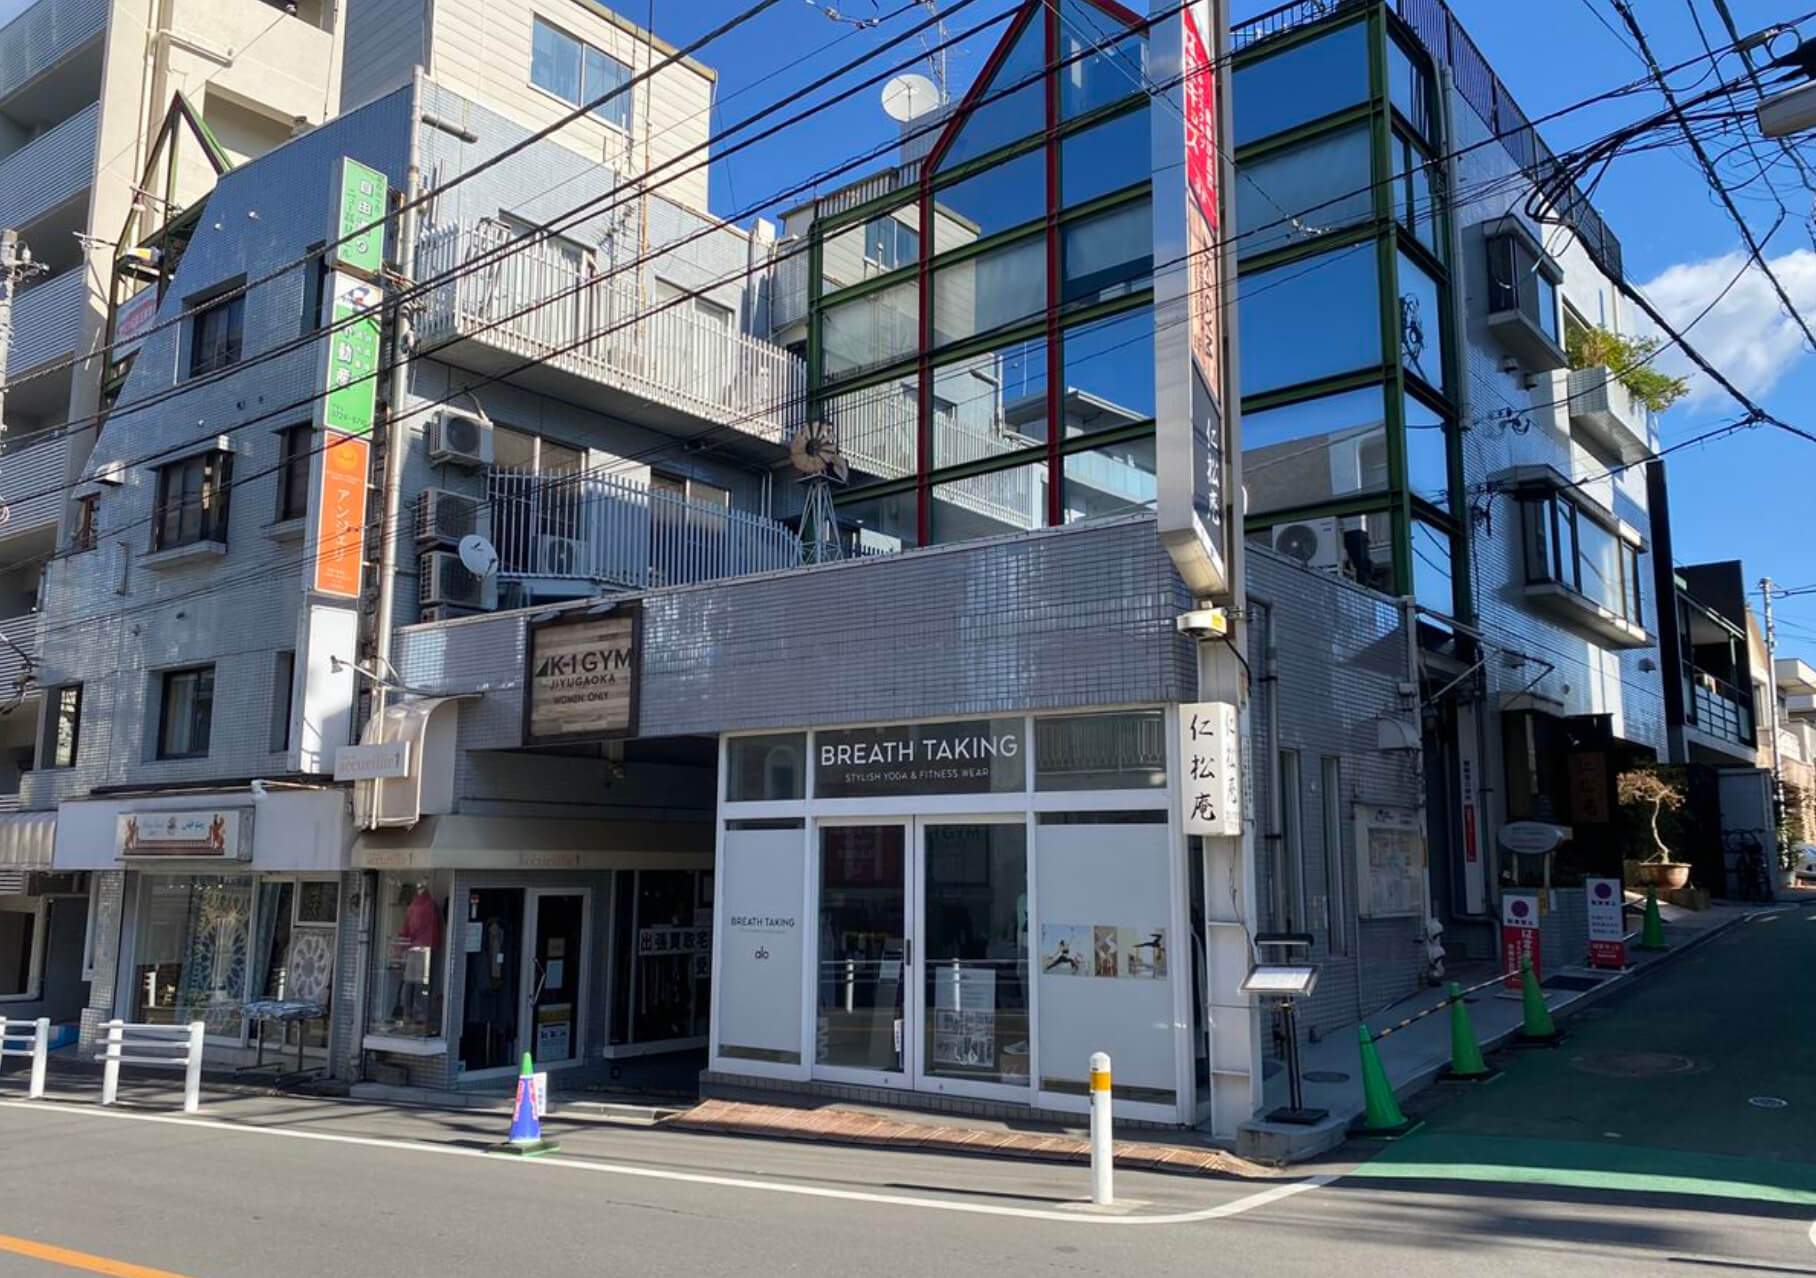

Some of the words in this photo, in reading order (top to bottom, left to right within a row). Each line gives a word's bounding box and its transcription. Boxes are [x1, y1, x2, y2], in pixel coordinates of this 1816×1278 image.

[551, 654, 577, 676] K-1
[582, 648, 632, 672] GYM
[550, 674, 616, 690] JIYUGAOKA
[553, 693, 584, 705] WOMEN
[587, 691, 609, 702] ONLY
[821, 740, 914, 766] BREATH
[922, 735, 1018, 760] TAKING
[845, 772, 881, 783] STYLISH
[883, 771, 908, 781] YOGA
[910, 769, 918, 780] &
[919, 768, 959, 780] FITNESS
[961, 767, 989, 777] WEAR
[1189, 713, 1216, 821] 仁松庵
[731, 916, 763, 928] BREATH
[764, 917, 795, 928] TAKING
